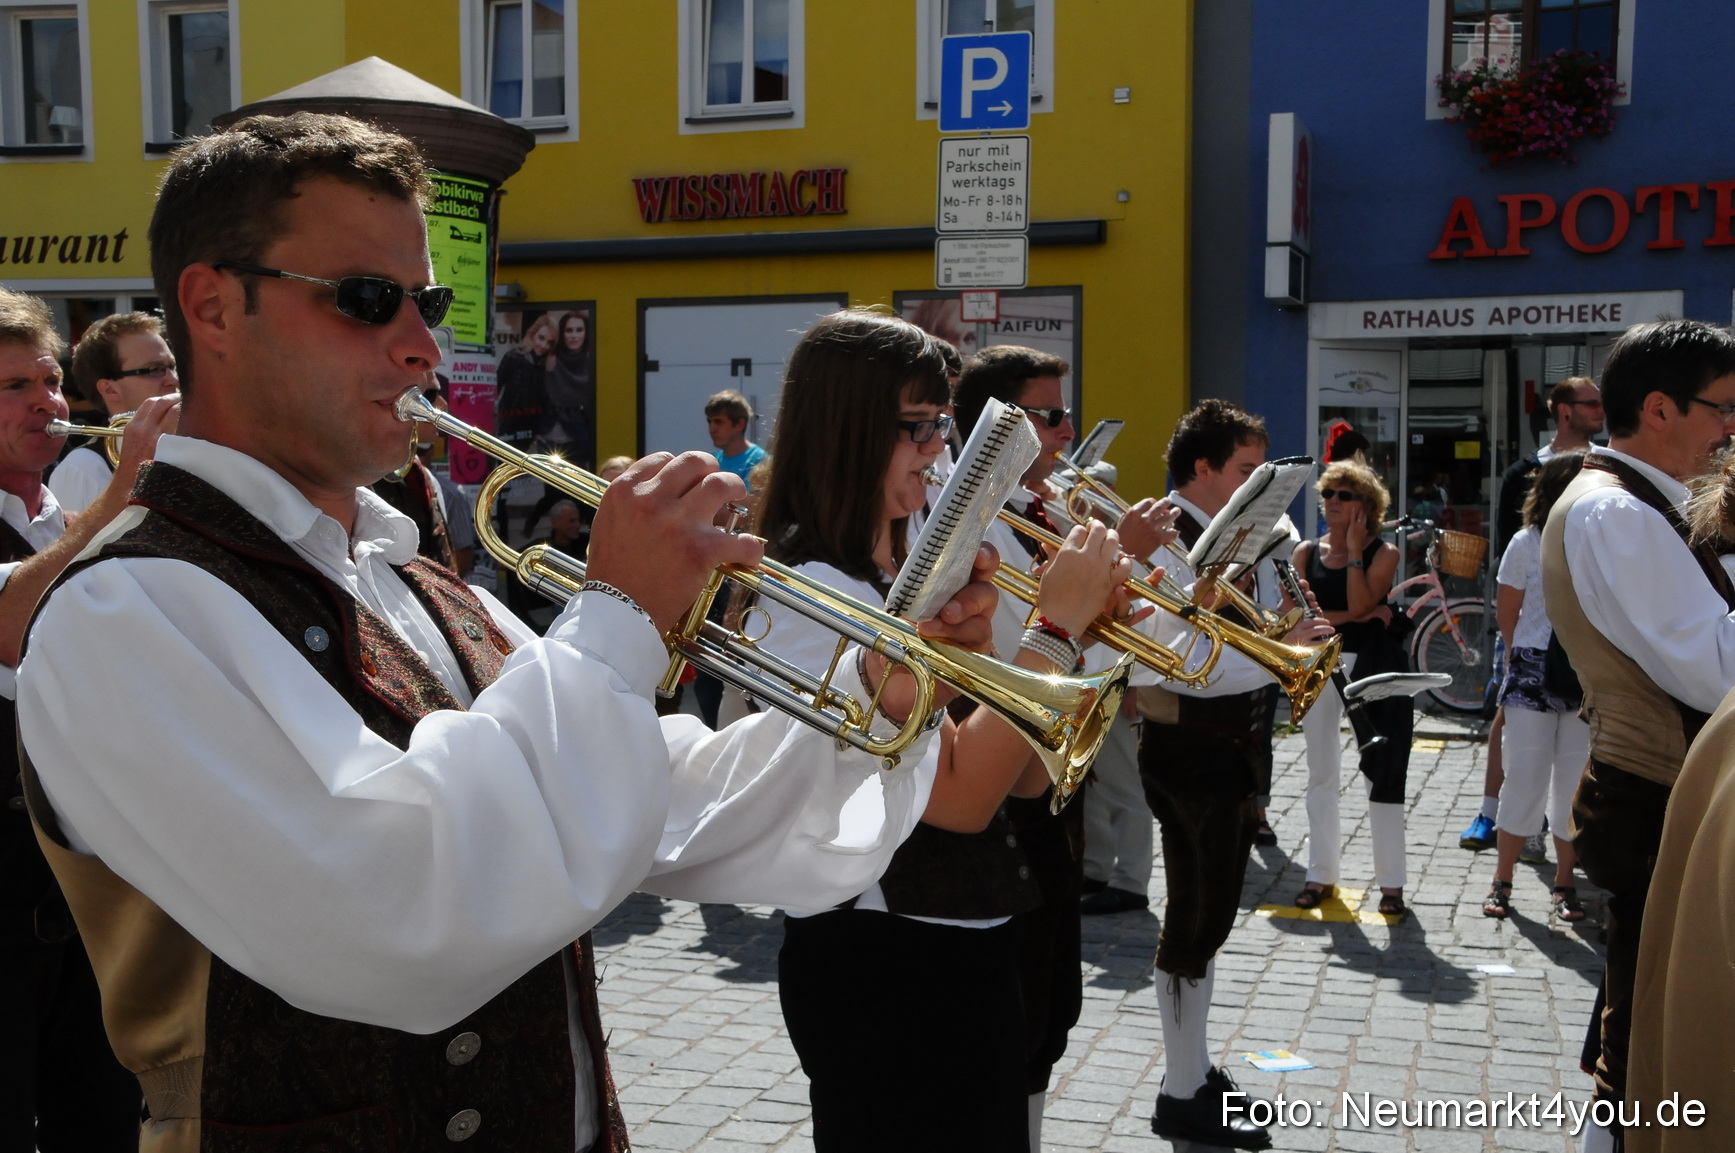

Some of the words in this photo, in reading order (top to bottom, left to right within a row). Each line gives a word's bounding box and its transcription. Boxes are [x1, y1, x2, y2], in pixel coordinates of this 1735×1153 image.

[961, 47, 1008, 118] P
[958, 147, 981, 157] nur
[988, 144, 1009, 156] mit
[946, 159, 1022, 173] Parkschein
[952, 176, 1015, 190] werktags
[632, 168, 847, 223] WISSMACH
[943, 212, 958, 223] Sa
[1363, 308, 1474, 329] RATHAUS
[1488, 303, 1622, 325] APOTHEKE
[990, 319, 1062, 333] TAIFUN
[453, 362, 478, 372] ANDY
